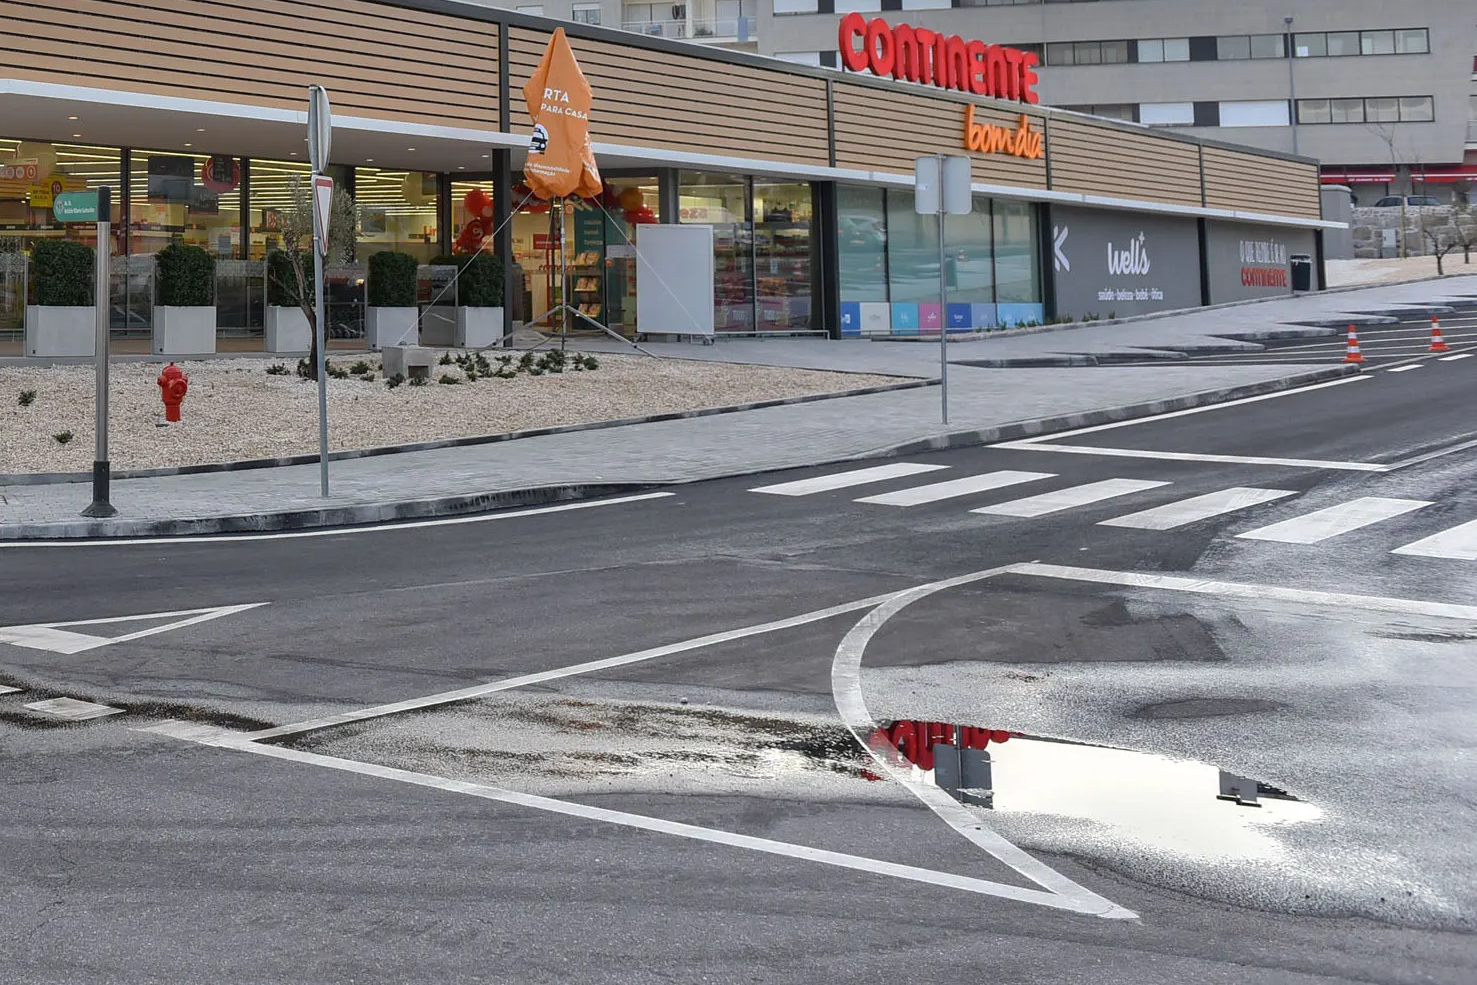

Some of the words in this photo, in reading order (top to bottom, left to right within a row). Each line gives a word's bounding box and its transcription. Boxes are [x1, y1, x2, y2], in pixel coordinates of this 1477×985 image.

[839, 12, 1039, 104] CONTINENTE
[544, 87, 570, 103] RTA
[541, 103, 563, 114] PARA
[564, 108, 588, 120] CASA
[964, 103, 1014, 153] bom
[1014, 115, 1044, 159] dia
[1241, 267, 1288, 287] CONTINENTE
